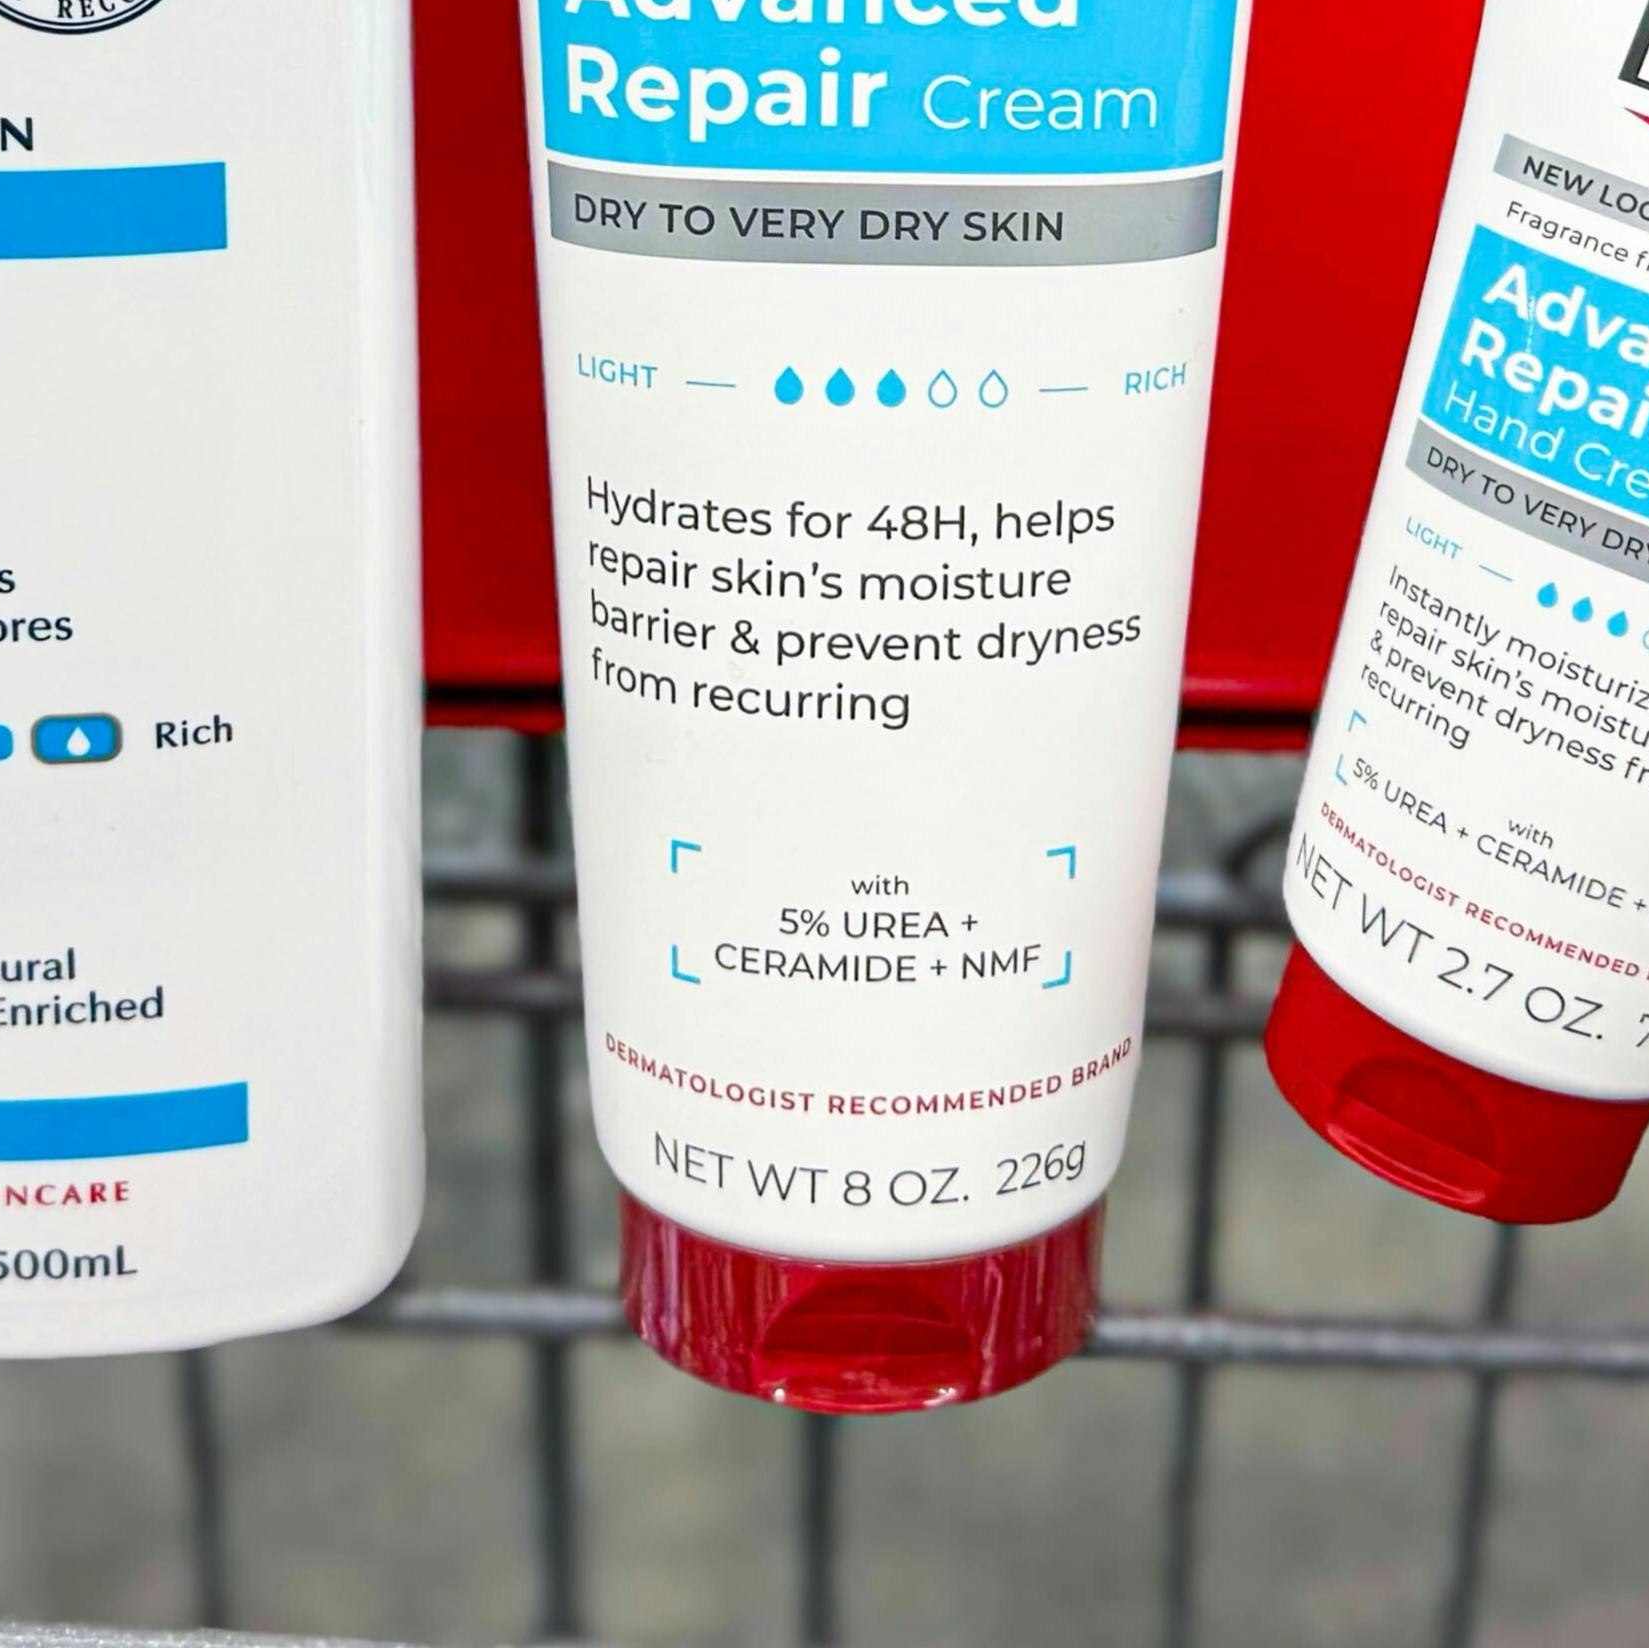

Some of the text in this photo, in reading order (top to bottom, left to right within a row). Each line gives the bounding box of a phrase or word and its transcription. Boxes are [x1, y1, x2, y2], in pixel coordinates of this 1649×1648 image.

[566, 42, 1159, 143] Repair Cream
[1521, 153, 1593, 201] NEW
[573, 192, 1065, 244] DRY TO VERY DRY SKIN
[1505, 200, 1629, 264] Fragrance
[576, 352, 1188, 396] LIGHT RICH
[1443, 381, 1567, 464] Hand
[586, 474, 1115, 548] Hydrates for 48H, helps
[1425, 444, 1478, 488] DRY
[1479, 473, 1517, 507] TO
[1523, 492, 1598, 541] VERY
[588, 538, 699, 591] repair
[859, 562, 1072, 602] moisture
[1404, 516, 1465, 562] LIGHT
[590, 587, 1142, 667] barrier & prevent dryness
[1379, 597, 1449, 659] repair
[1388, 564, 1503, 649] Instantly
[591, 646, 912, 731] from recurring
[1360, 659, 1472, 750] recurring
[1368, 628, 1384, 655] &
[1384, 643, 1488, 719] prevent
[1494, 701, 1616, 774] dryness
[154, 714, 234, 750] Rich
[1352, 756, 1380, 792] 5%
[1382, 779, 1449, 835] UREA
[1456, 825, 1469, 840] +
[1475, 833, 1628, 911] CERAMIDE
[1632, 897, 1648, 913] +
[1506, 818, 1555, 850] with
[850, 873, 910, 897] with
[1319, 800, 1460, 908] DERMATOLOGIST
[1464, 901, 1641, 978] RECOMMENDED
[778, 908, 980, 939] 5% UREA +
[1295, 832, 1353, 911] NET
[1358, 892, 1436, 965] WT
[1436, 945, 1515, 1003] 2.7
[1523, 985, 1605, 1042] OZ.
[713, 942, 1042, 984] CERAMIDE + NMF
[604, 1030, 1134, 1117] DERMATOLOGIST RECOMMENDED BRAND
[654, 1130, 1088, 1208] NET WT 8 OZ. 226g
